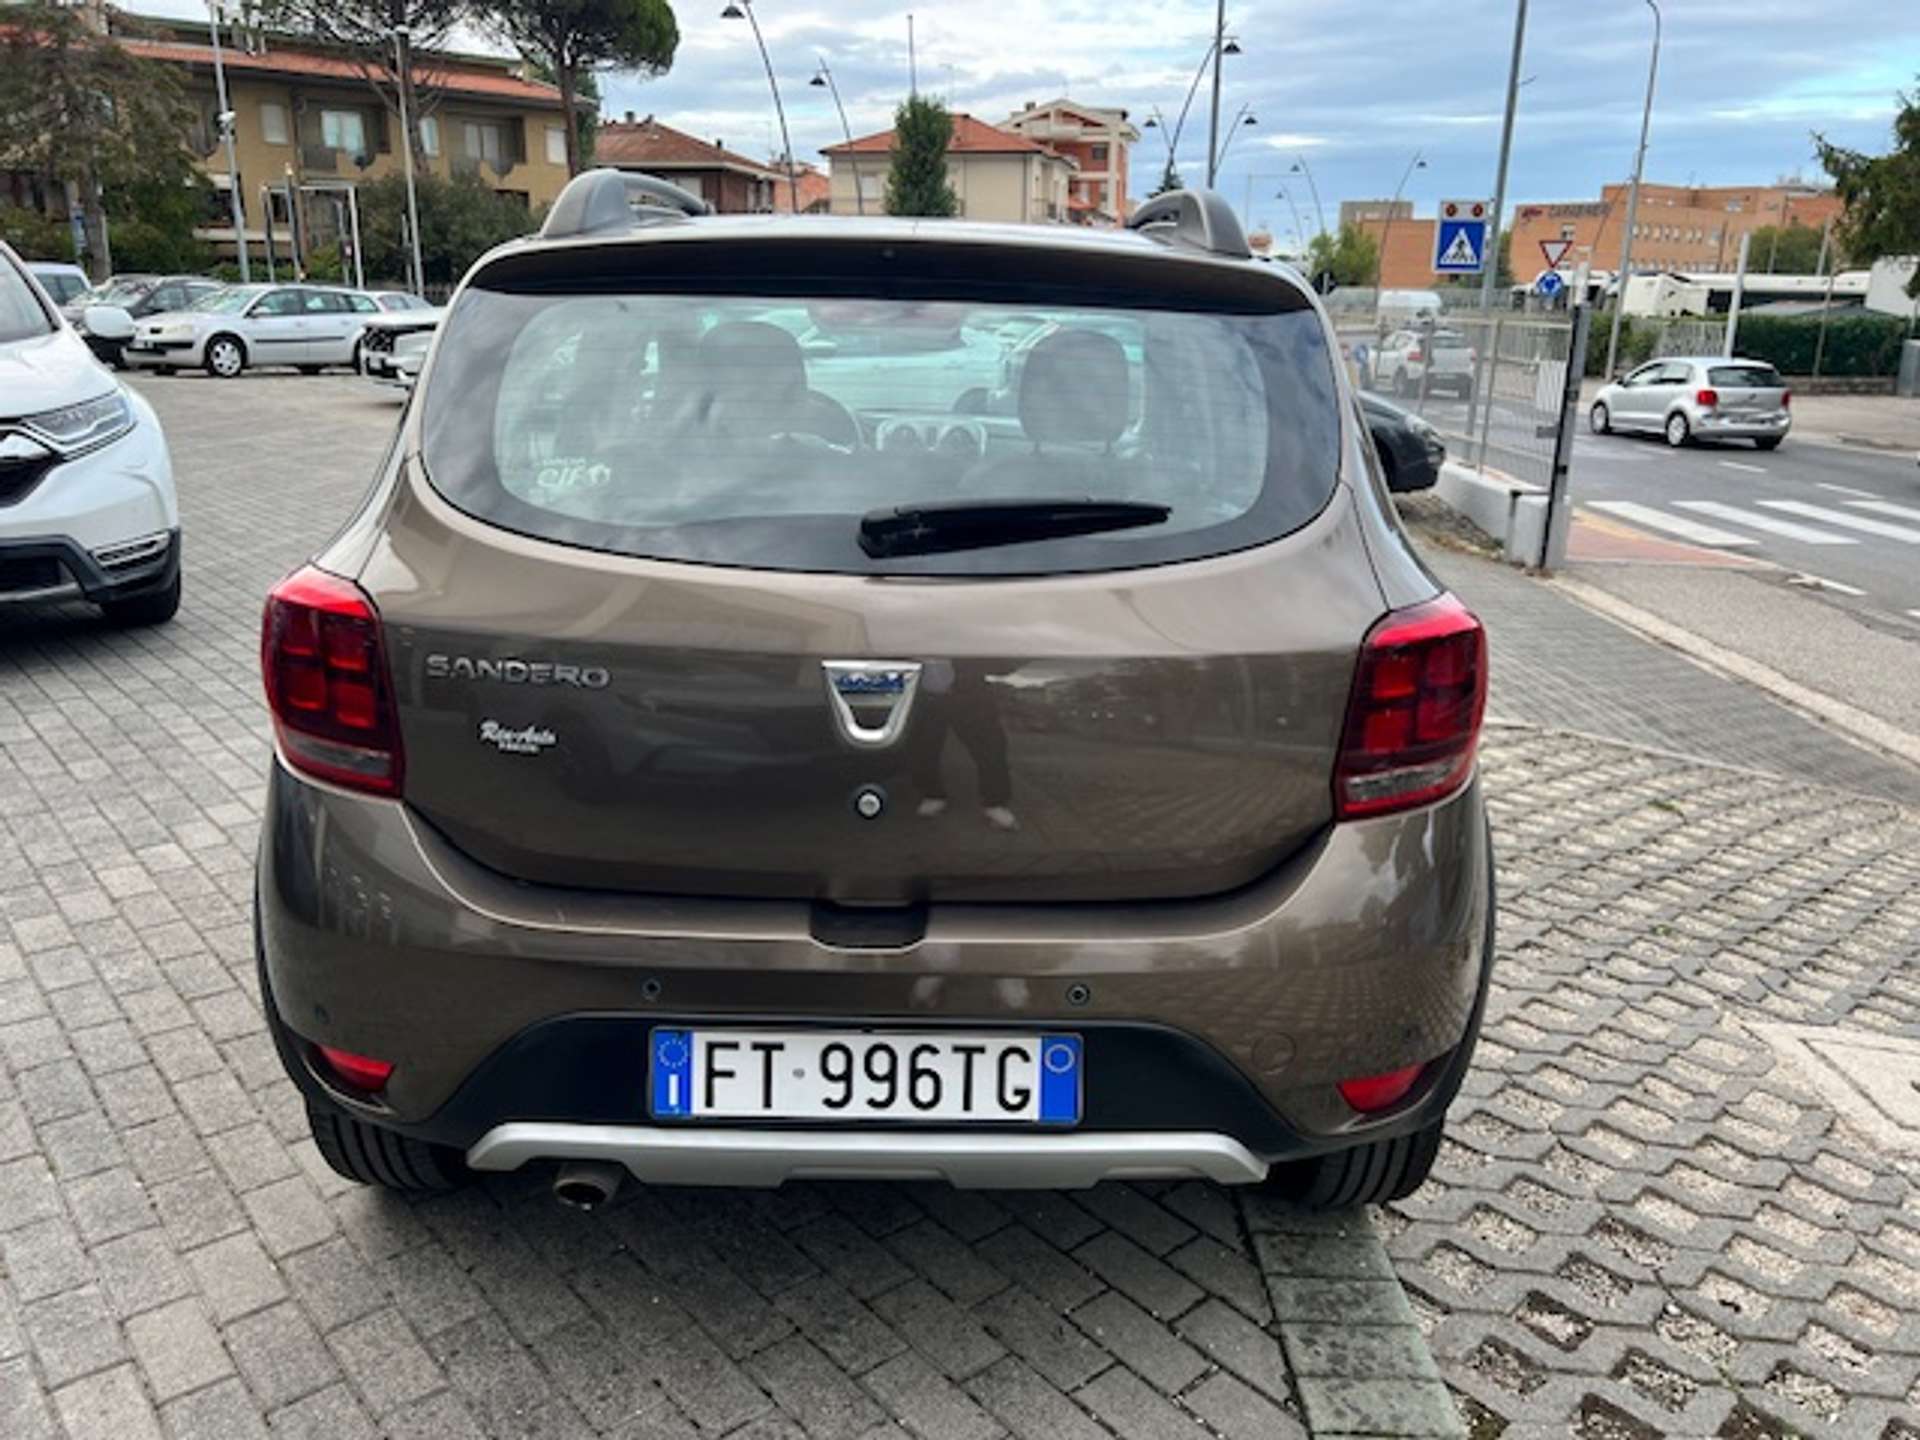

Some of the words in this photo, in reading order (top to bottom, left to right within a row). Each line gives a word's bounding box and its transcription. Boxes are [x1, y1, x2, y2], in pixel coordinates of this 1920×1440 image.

[425, 654, 610, 688] SANDERO
[705, 1041, 784, 1110] FT
[819, 1042, 1031, 1112] 996TG
